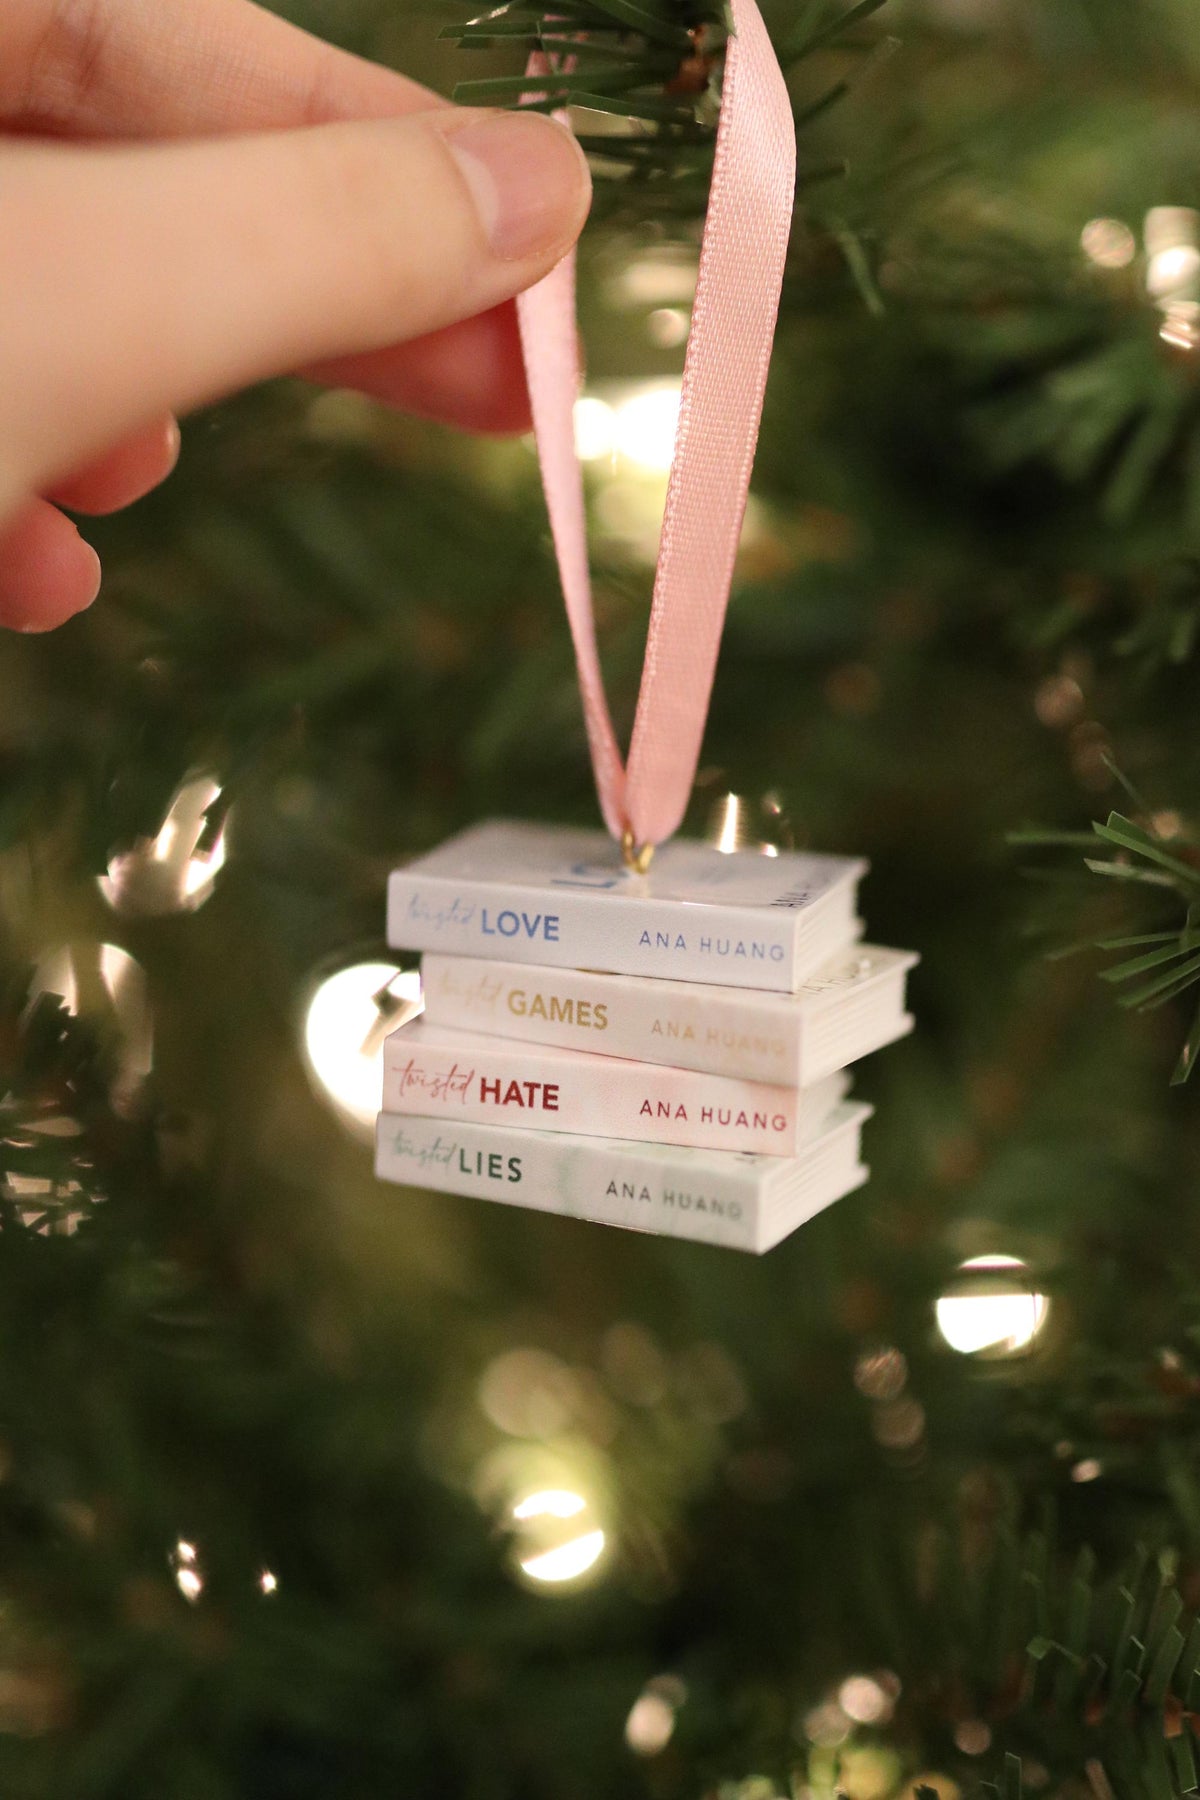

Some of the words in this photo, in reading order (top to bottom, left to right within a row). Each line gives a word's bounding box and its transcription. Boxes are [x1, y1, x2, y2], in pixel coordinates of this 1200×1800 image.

[481, 908, 560, 942] LOVE
[639, 930, 687, 950] ANA
[699, 937, 785, 962] HUANG
[507, 989, 609, 1031] GAMES
[651, 1019, 695, 1040] ANA
[391, 1058, 476, 1105] twisted
[479, 1077, 560, 1111] HATE
[639, 1099, 688, 1121] ANA
[701, 1106, 788, 1132] HUANG
[459, 1147, 523, 1183] LIES
[606, 1180, 652, 1203] ANA
[663, 1189, 744, 1221] HUANG
